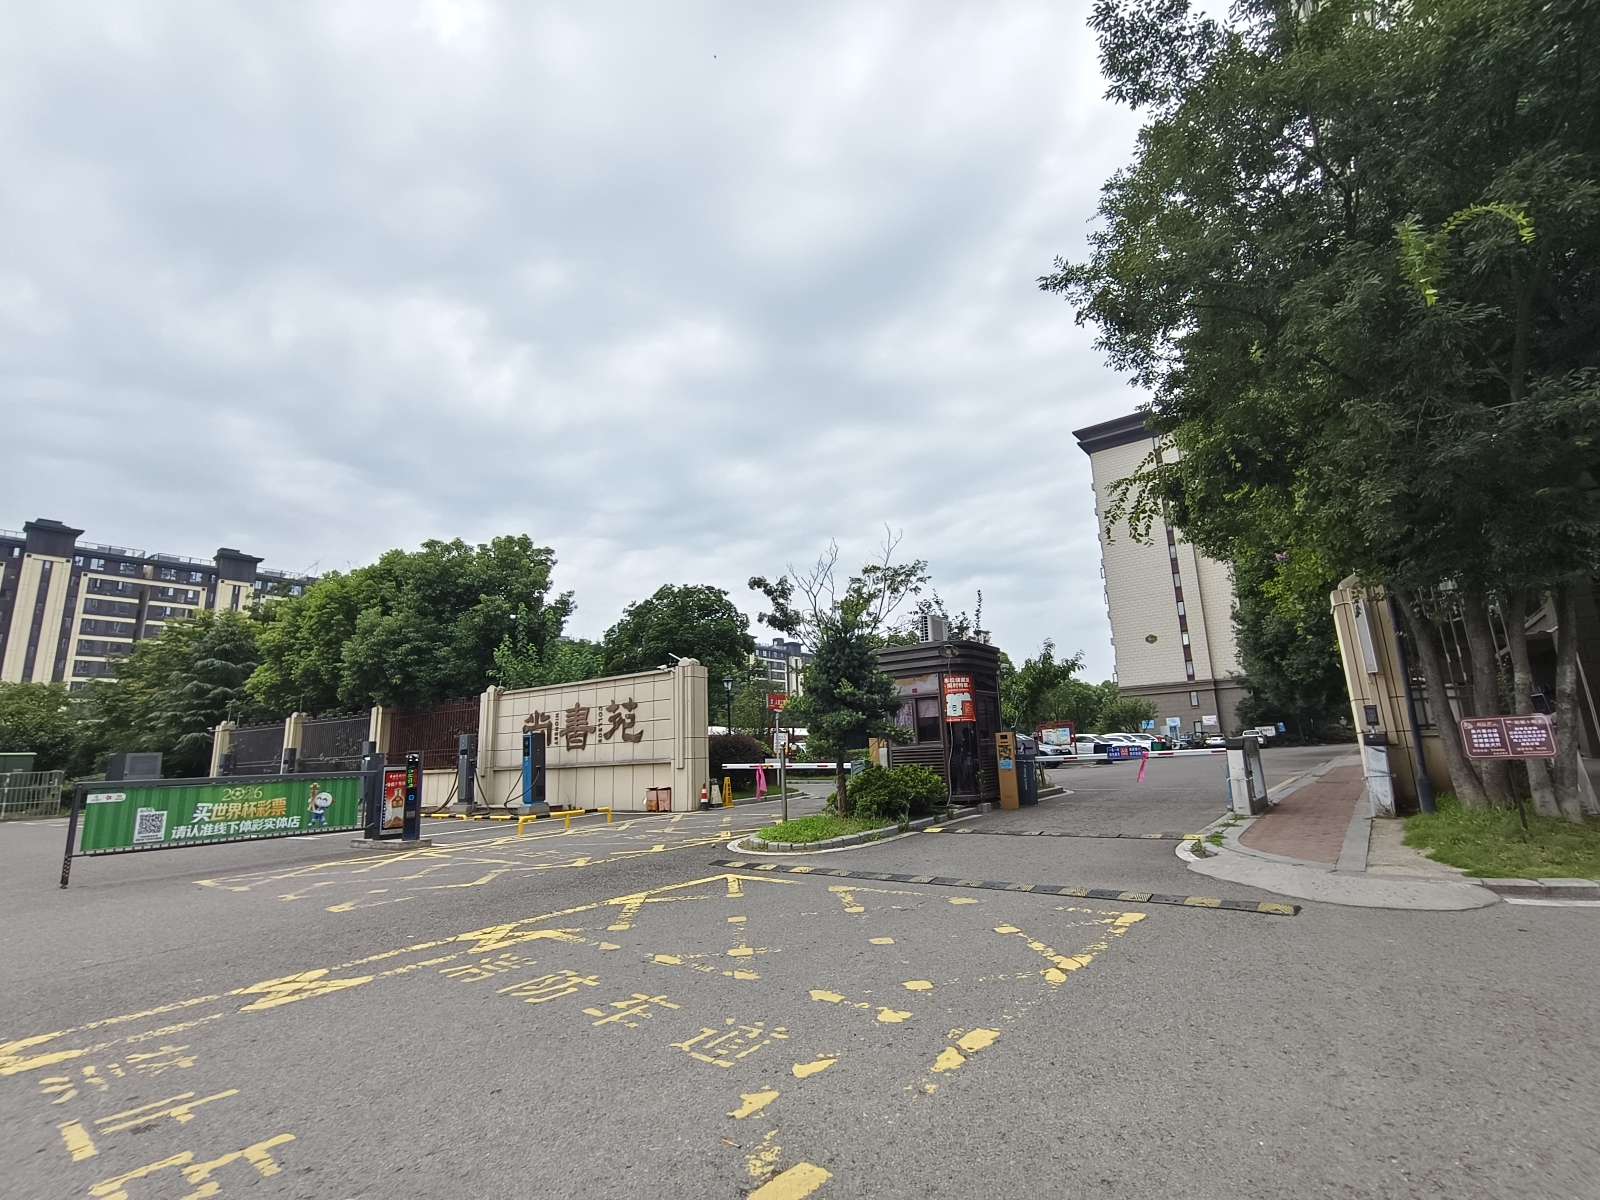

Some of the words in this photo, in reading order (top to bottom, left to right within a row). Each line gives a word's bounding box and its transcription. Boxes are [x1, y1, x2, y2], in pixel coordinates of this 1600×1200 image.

[191, 797, 287, 823] 买世界杯彩票
[171, 815, 302, 839] 请认准线下体彩实体店
